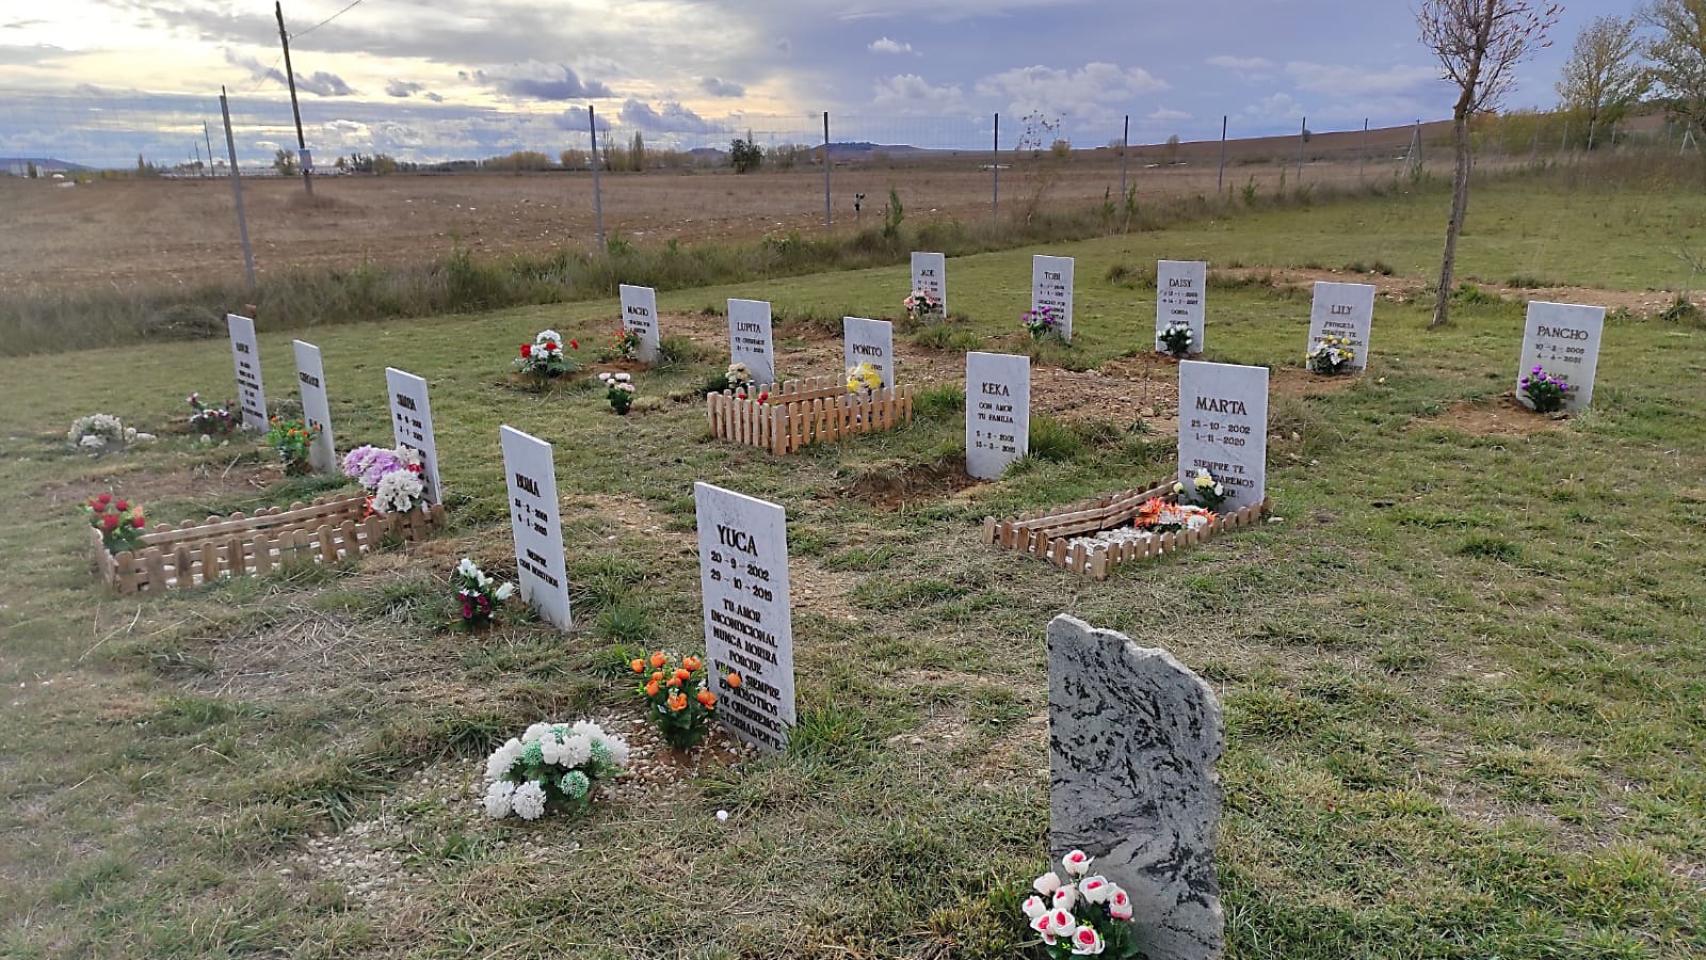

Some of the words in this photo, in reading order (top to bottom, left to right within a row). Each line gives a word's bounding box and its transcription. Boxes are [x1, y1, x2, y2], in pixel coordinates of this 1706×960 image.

[1169, 278, 1192, 288] DAISY
[1330, 304, 1353, 315] LILY
[737, 321, 761, 334] LUPITA
[1536, 325, 1589, 340] PANCHO
[982, 382, 1010, 397] KEKA
[978, 412, 986, 420] TU
[988, 414, 1014, 424] FAMILIA
[1196, 396, 1248, 416] MARTA
[1228, 424, 1250, 434] 2002
[1193, 458, 1230, 472] SIEMPRE
[1232, 464, 1244, 474] TE
[717, 524, 758, 557] YUCA
[711, 550, 722, 563] 20
[747, 564, 770, 582] 2002
[710, 568, 720, 581] 29
[752, 584, 773, 602] 2019
[723, 598, 734, 612] TU
[737, 604, 761, 622] AMOR
[711, 609, 778, 648] INCONDICIONAL
[713, 626, 742, 650] NUNCA
[744, 640, 778, 666] MORIRA
[729, 650, 762, 674] PORQUE
[745, 674, 781, 700] SIEMPRE
[733, 686, 778, 716] NOSOTROS
[732, 700, 780, 733] QUEREMOS
